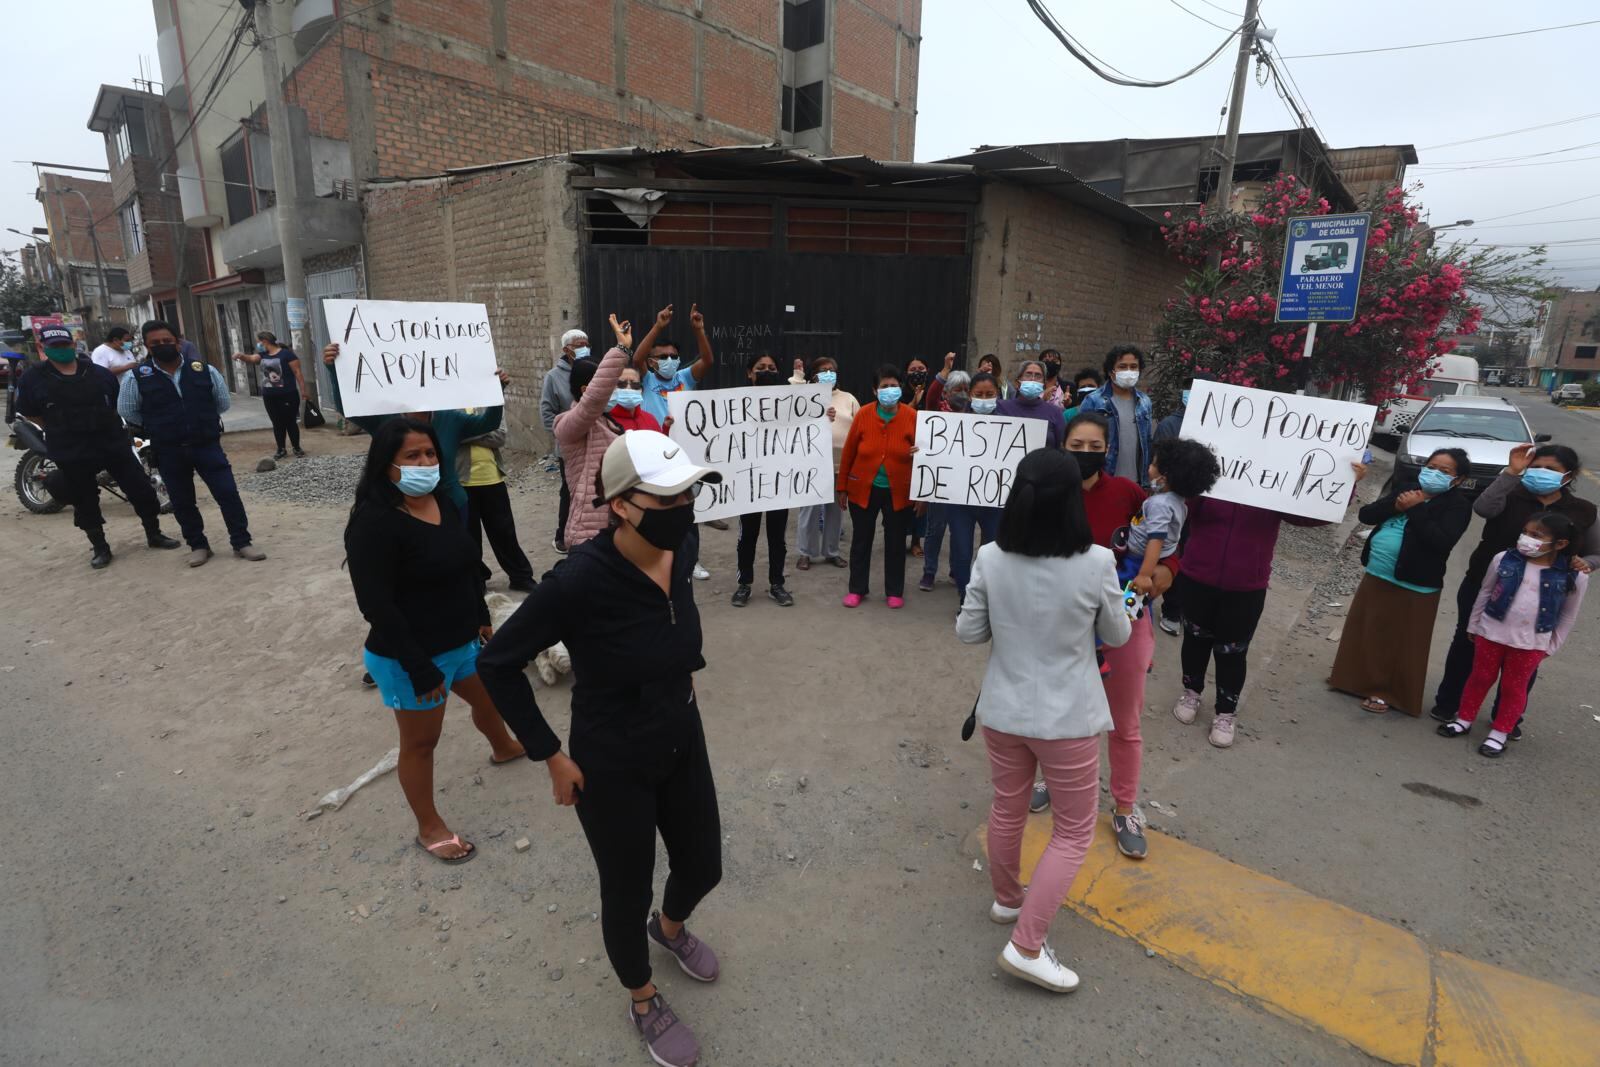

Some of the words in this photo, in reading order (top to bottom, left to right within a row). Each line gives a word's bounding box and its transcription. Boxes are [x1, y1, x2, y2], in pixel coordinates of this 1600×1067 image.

[1311, 218, 1365, 229] MUNICIPALIDAD
[1319, 229, 1329, 237] DE
[1330, 227, 1355, 236] COMAS
[1300, 275, 1342, 283] PARADERO
[1315, 282, 1344, 290] MENOR
[712, 324, 772, 339] MANZANA
[354, 350, 460, 393] APOYEN
[684, 393, 825, 442] QUEREMOS
[1200, 391, 1254, 428] NO
[1262, 395, 1369, 451] PODEMOS
[704, 423, 824, 463] CAMINAR
[925, 415, 1027, 462] BASTA
[736, 463, 823, 503] TEMOR
[916, 464, 953, 501] DE
[1259, 469, 1289, 492] EN
[1292, 448, 1346, 505] PAZ
